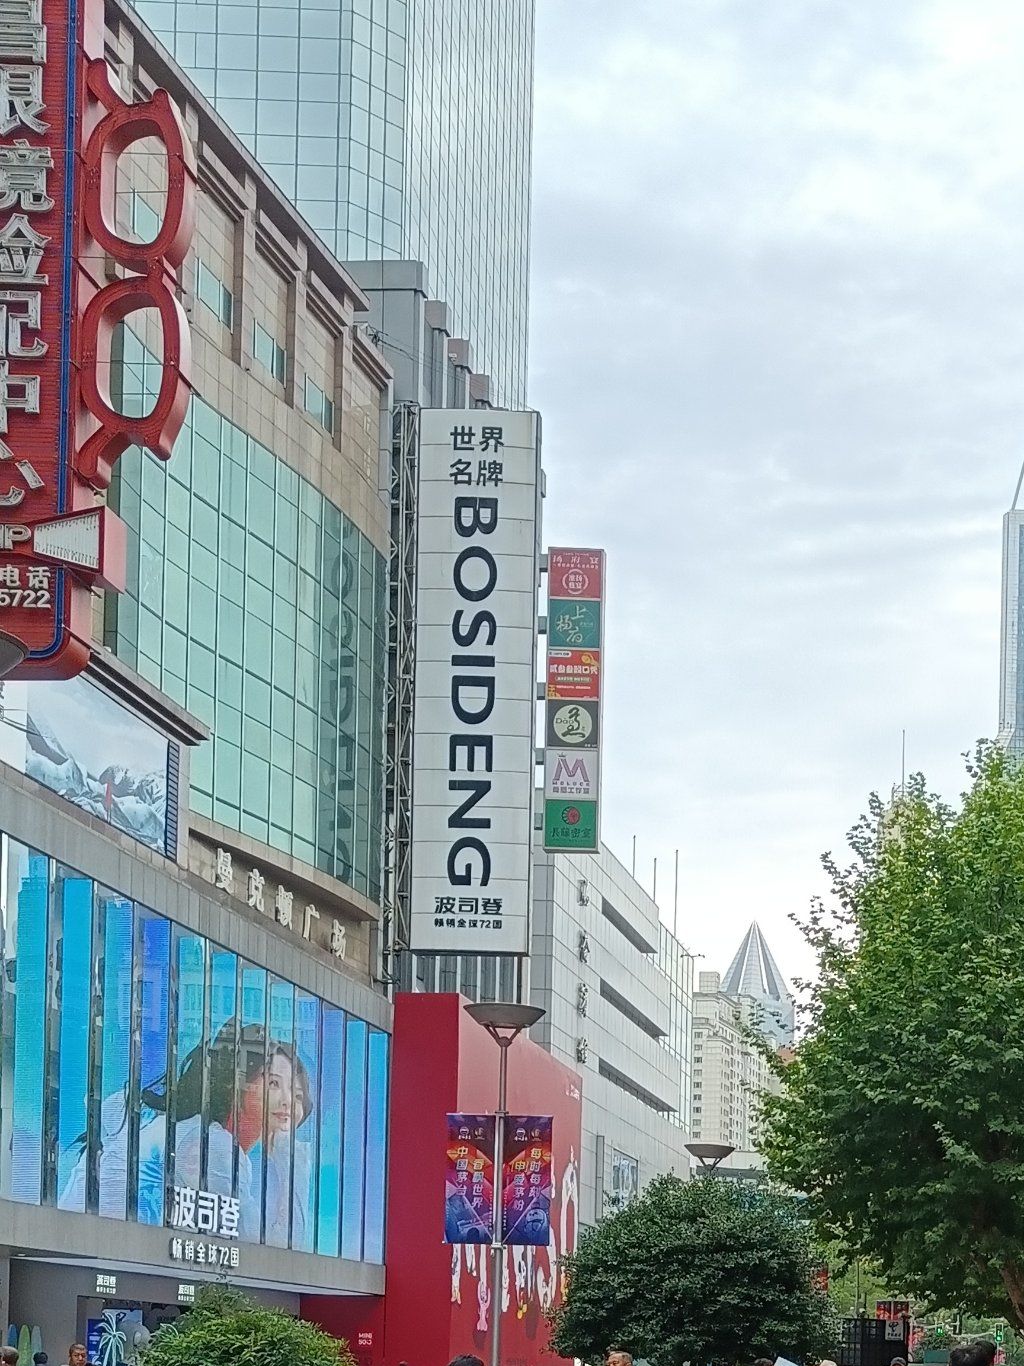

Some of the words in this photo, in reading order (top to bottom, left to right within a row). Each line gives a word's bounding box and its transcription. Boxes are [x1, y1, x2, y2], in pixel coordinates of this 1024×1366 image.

[450, 425, 504, 453] 世界
[449, 458, 504, 487] 名牌
[447, 496, 499, 887] BOSIDENG
[215, 847, 346, 961] 曼克顿广场
[434, 896, 503, 915] 波司登
[173, 1185, 240, 1237] 波司登
[172, 1237, 240, 1267] 畅销全球72国
